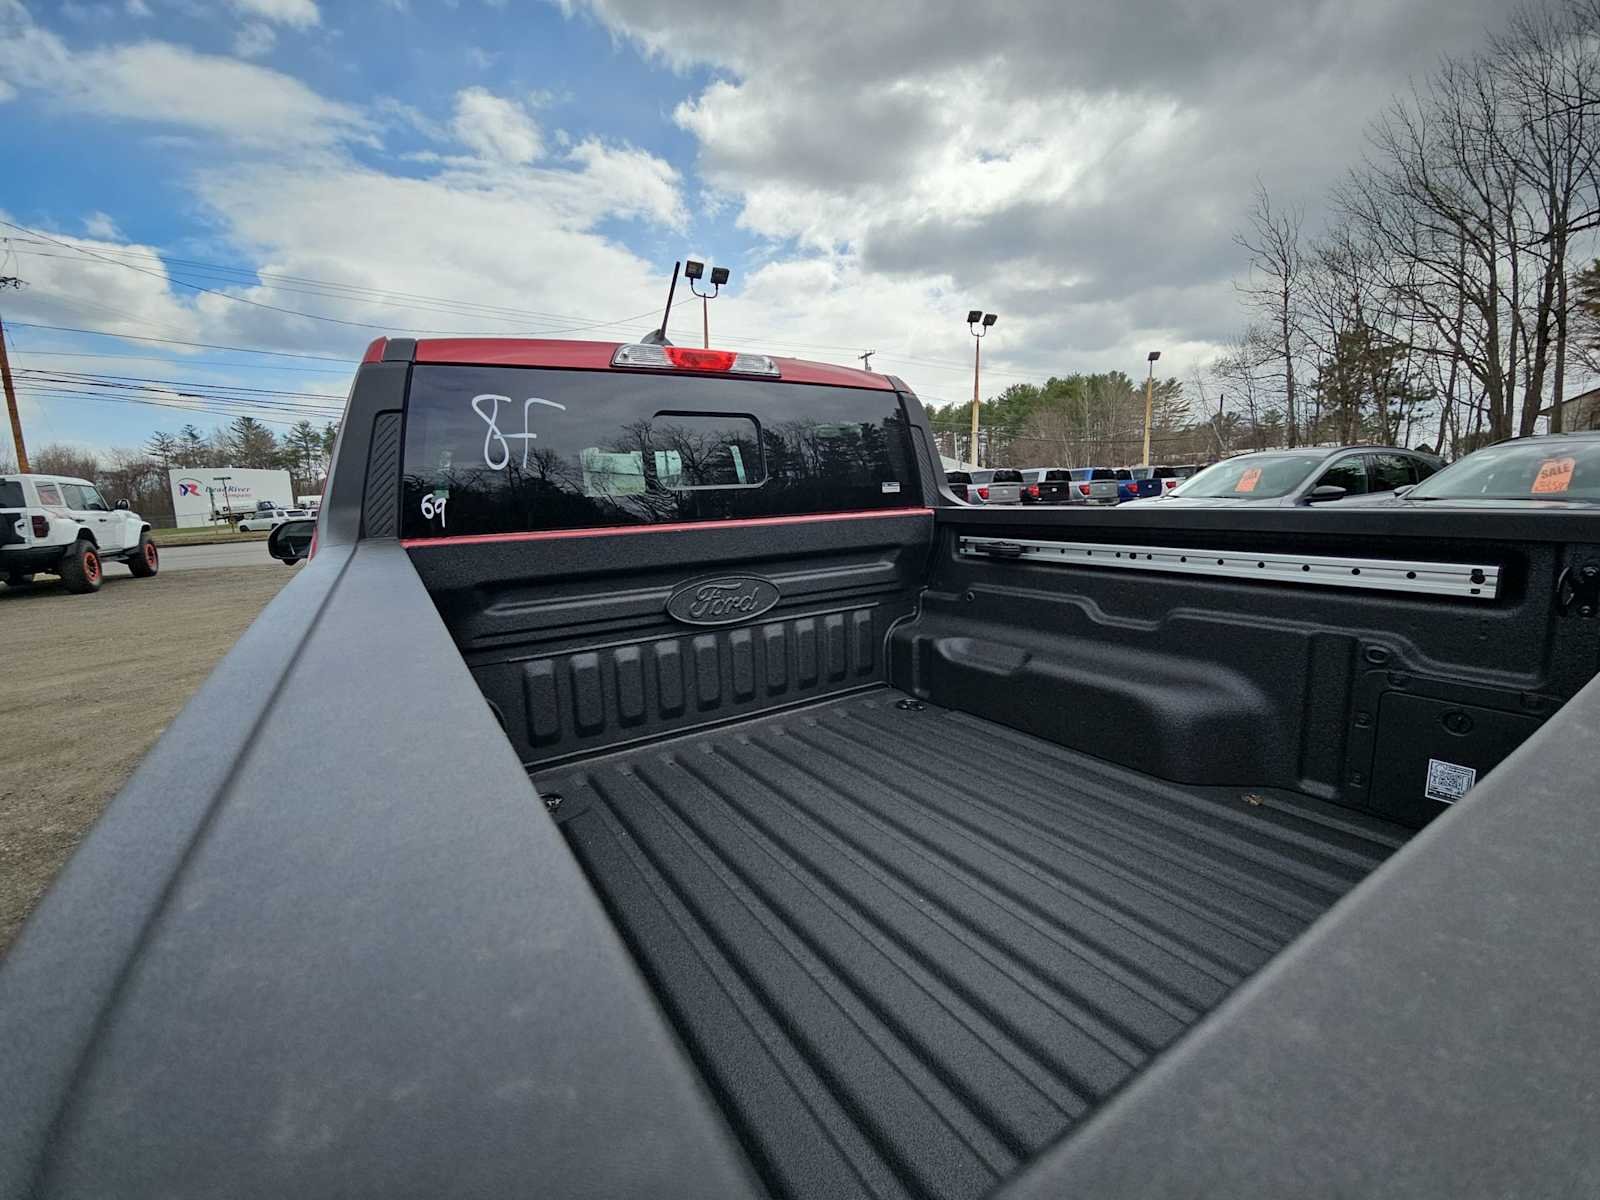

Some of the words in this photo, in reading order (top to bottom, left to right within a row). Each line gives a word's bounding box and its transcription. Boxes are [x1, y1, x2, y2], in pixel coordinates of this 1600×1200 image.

[1541, 463, 1571, 479] SALE
[421, 493, 447, 528] 69
[690, 583, 760, 617] Ford
